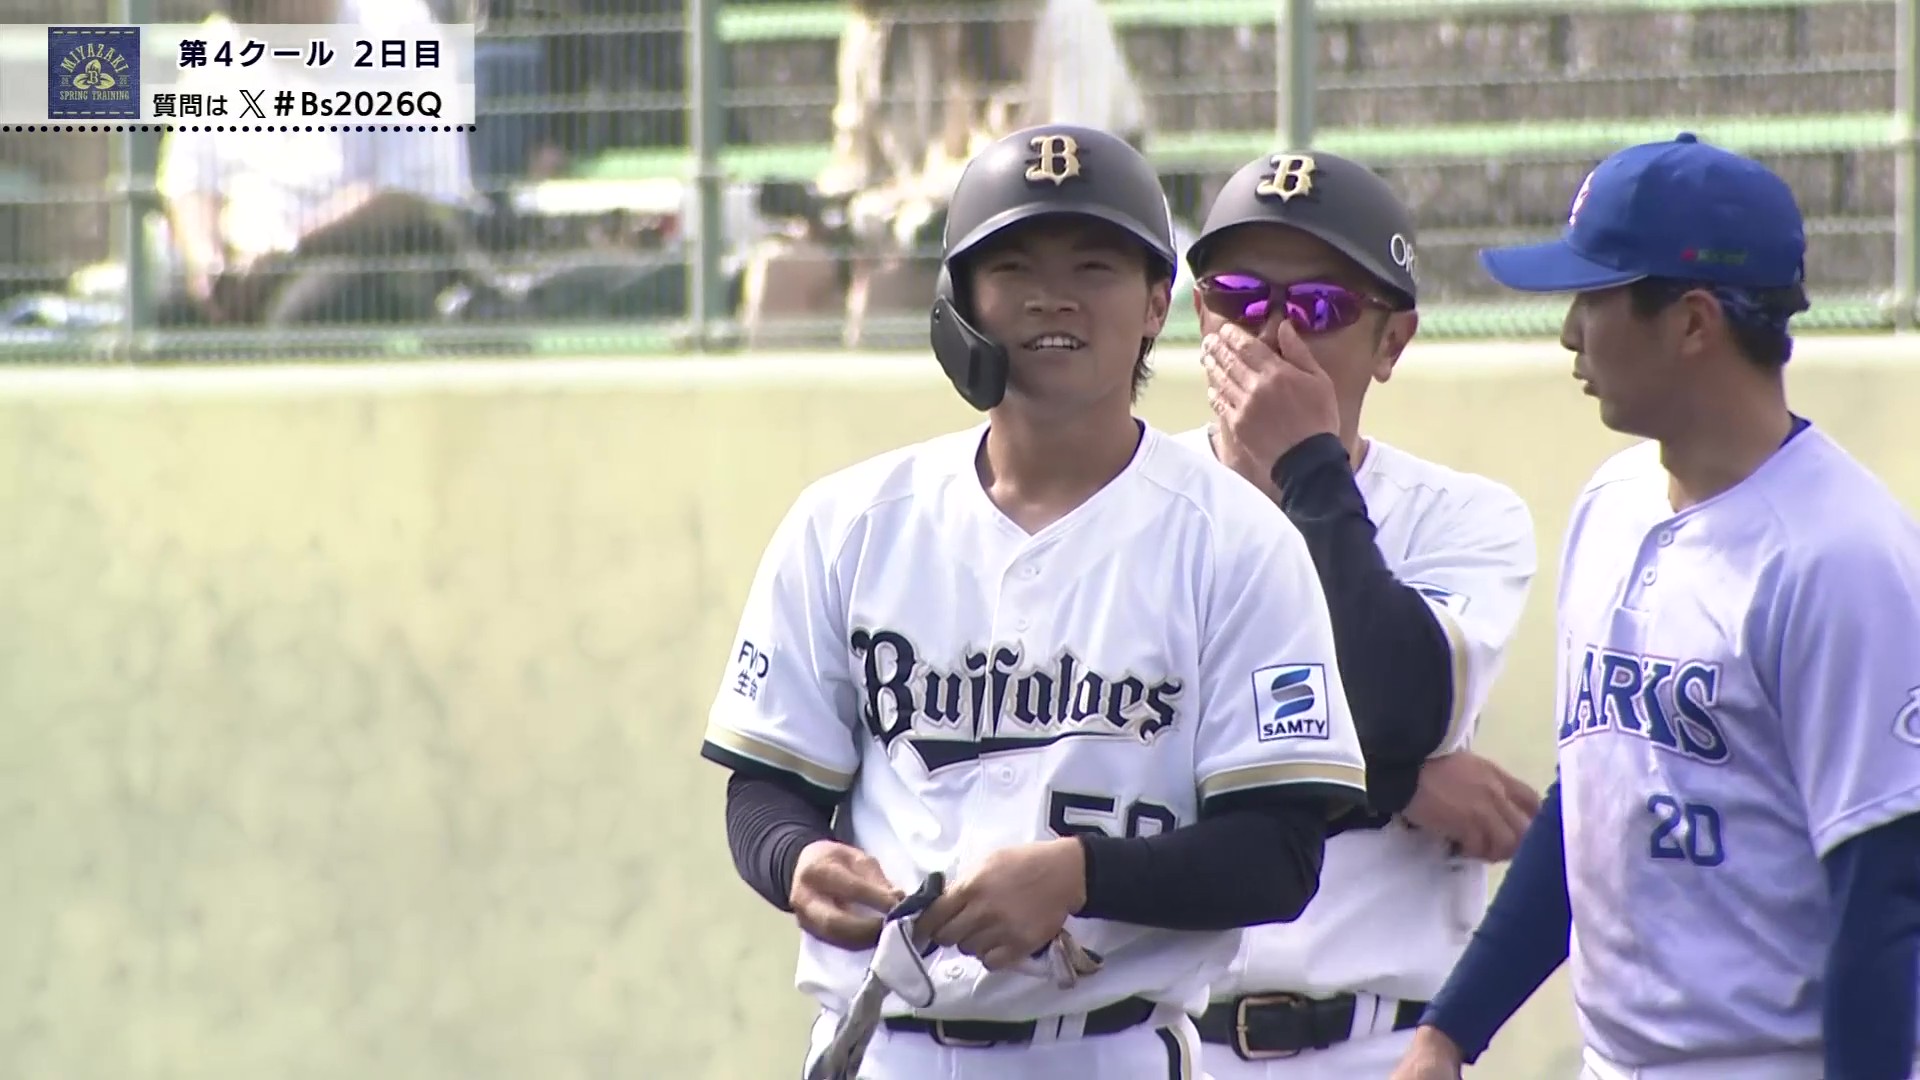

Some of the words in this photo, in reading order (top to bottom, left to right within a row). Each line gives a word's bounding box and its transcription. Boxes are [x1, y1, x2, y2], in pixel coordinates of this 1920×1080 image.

[1025, 134, 1080, 186] B
[1257, 154, 1316, 203] B
[851, 629, 1183, 747] Buffaloes
[1263, 718, 1326, 737] SAMTY
[1647, 794, 1726, 867] 20
